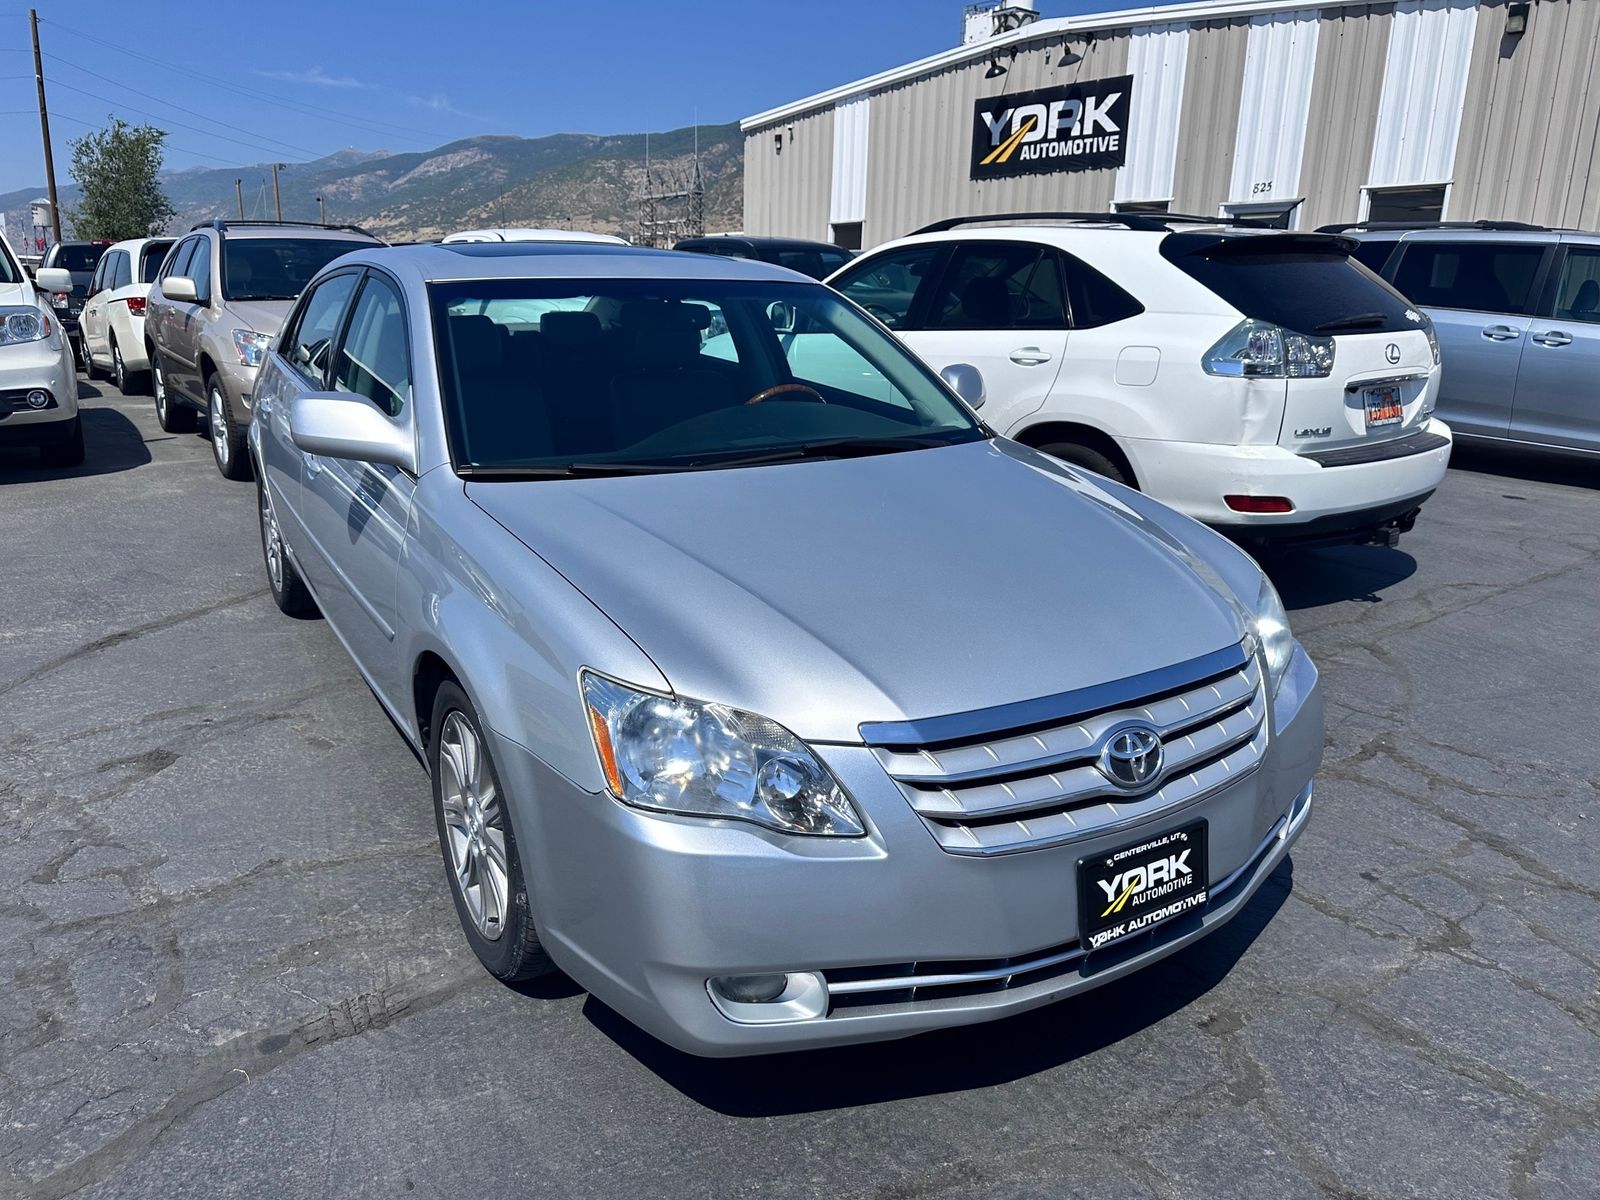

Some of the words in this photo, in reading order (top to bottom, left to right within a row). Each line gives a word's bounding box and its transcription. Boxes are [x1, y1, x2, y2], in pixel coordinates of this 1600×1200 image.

[980, 92, 1122, 146] YORK
[1019, 135, 1120, 161] AUTOMOTIVE
[1294, 426, 1332, 437] LEXUS
[1170, 832, 1181, 841] UT
[1096, 848, 1193, 903] YORK
[1131, 874, 1193, 907] AUTOMOTIVE
